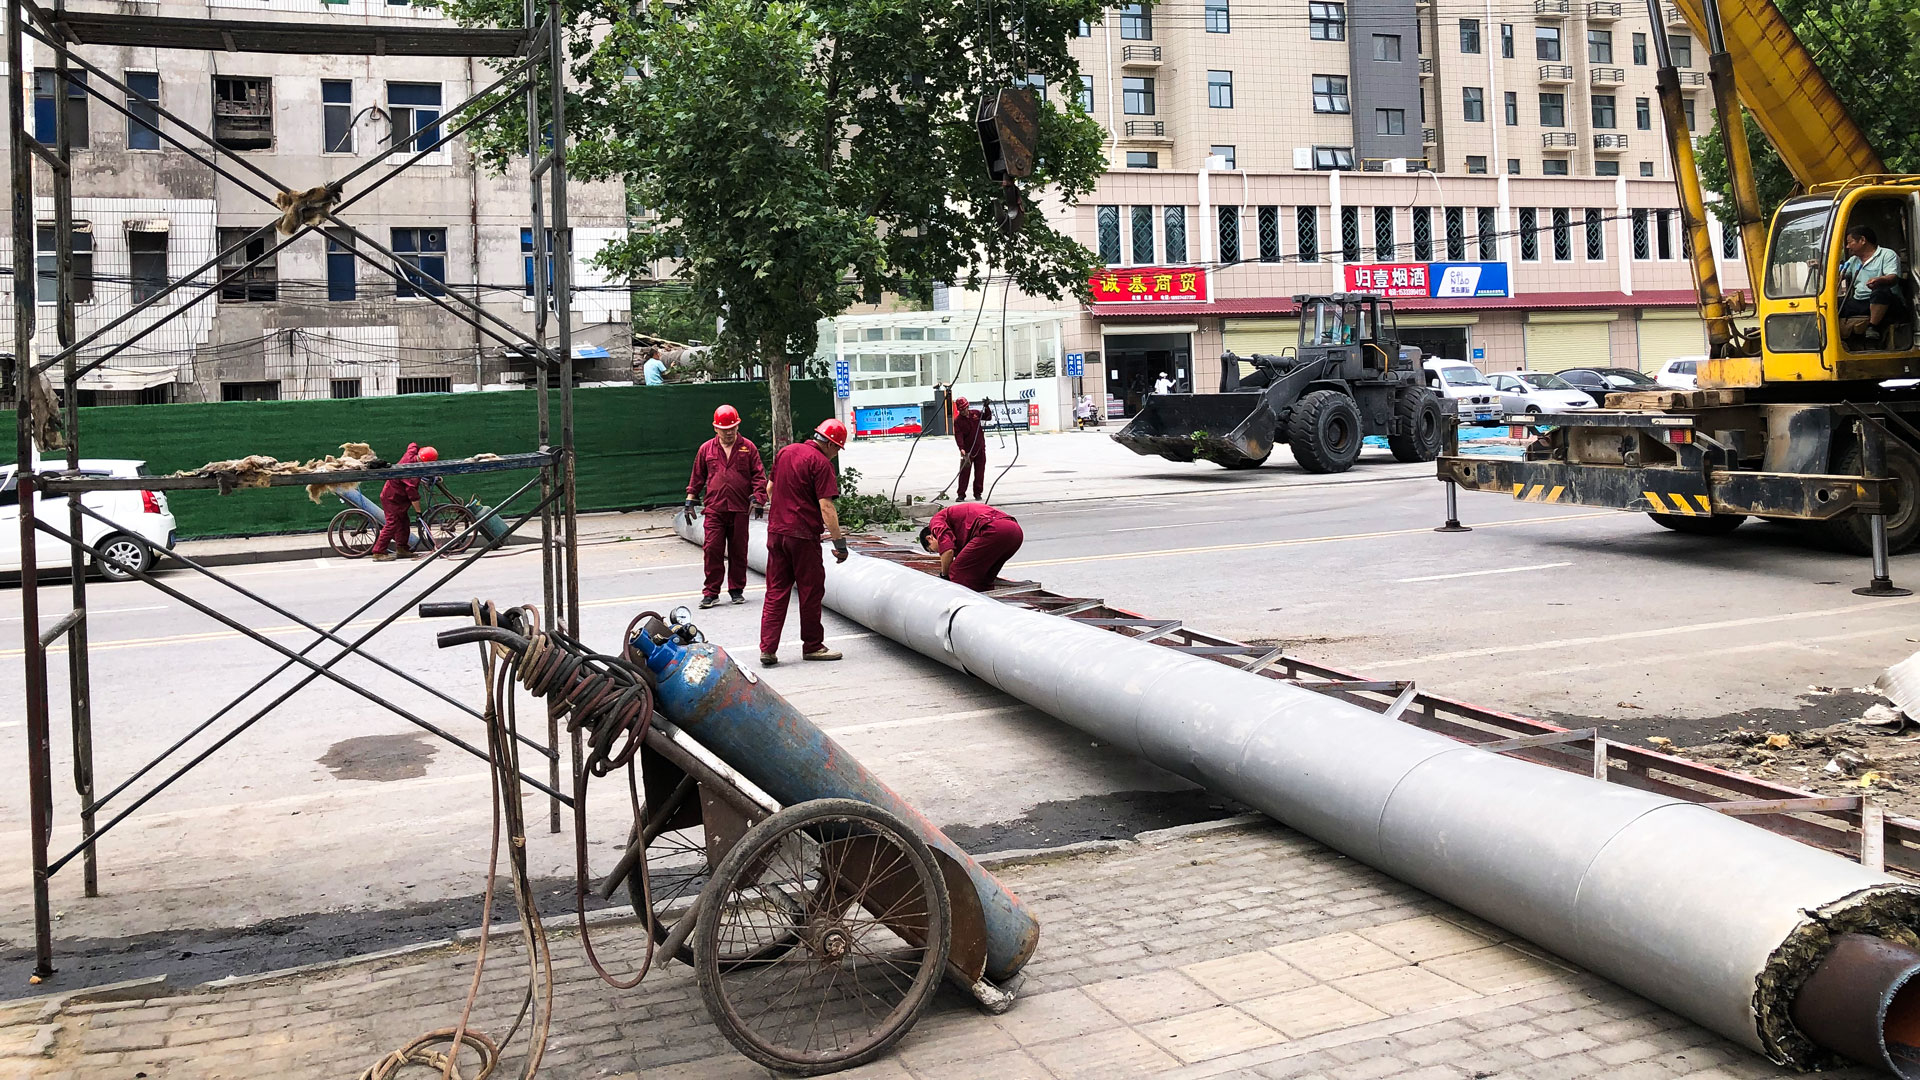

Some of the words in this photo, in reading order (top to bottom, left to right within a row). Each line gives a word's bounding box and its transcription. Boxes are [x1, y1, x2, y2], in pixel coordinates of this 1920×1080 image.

[1100, 273, 1197, 293] 诚基商贸
[1355, 267, 1425, 288] 归壹烟酒
